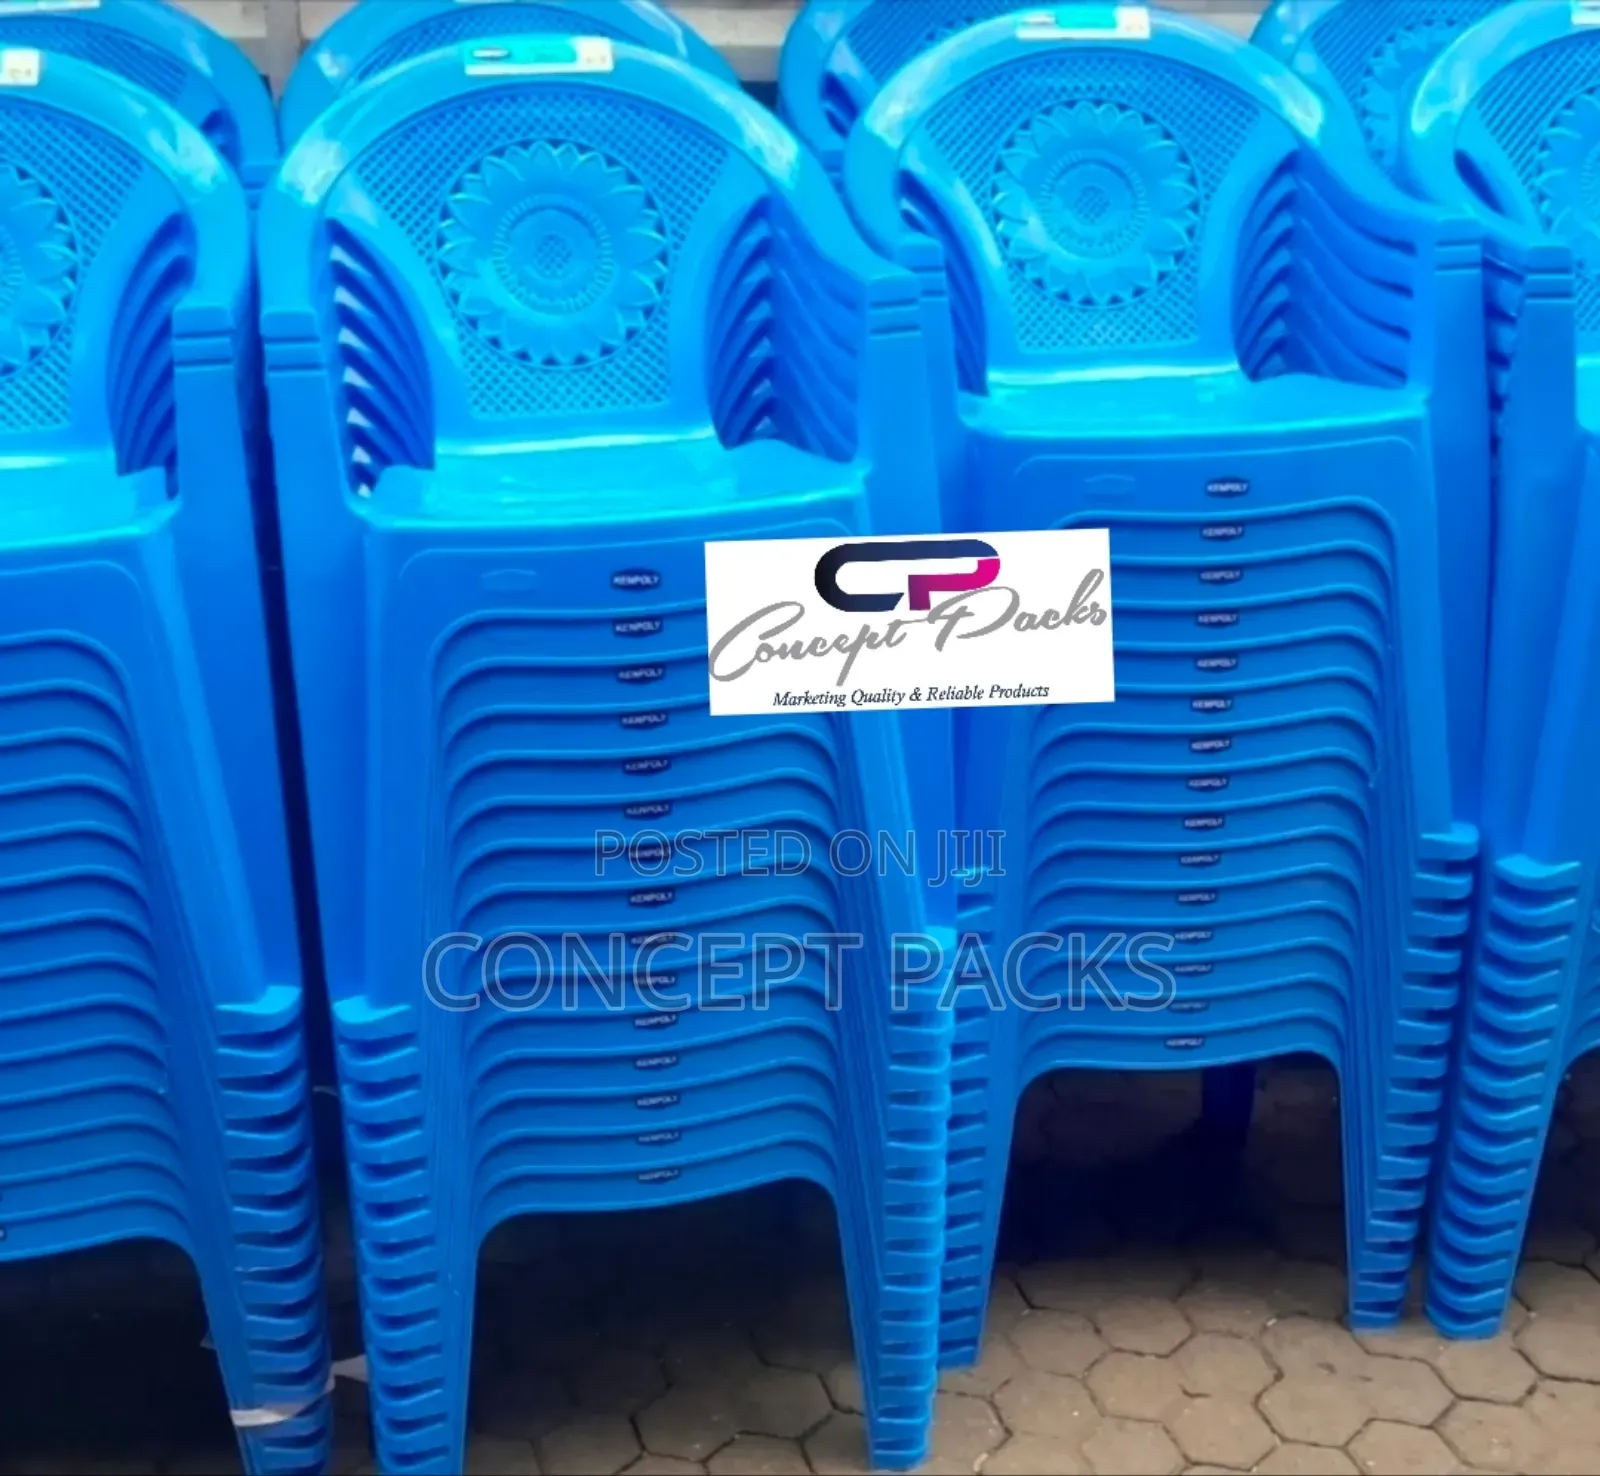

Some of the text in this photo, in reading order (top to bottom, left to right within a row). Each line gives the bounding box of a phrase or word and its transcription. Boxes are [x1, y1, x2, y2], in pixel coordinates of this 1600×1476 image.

[1208, 483, 1248, 492] KENPOLY
[1203, 527, 1242, 536] KENPOLY
[1201, 570, 1241, 579] KENPOLY
[613, 575, 659, 586] KENPOLY
[1198, 614, 1238, 623] KENPOLY
[616, 621, 661, 632] KENPOLY
[1197, 659, 1237, 668] KENPOLY
[619, 668, 663, 679] KENPOLY
[1193, 700, 1232, 709] KENPOLY
[1192, 740, 1230, 750] KENPOLY
